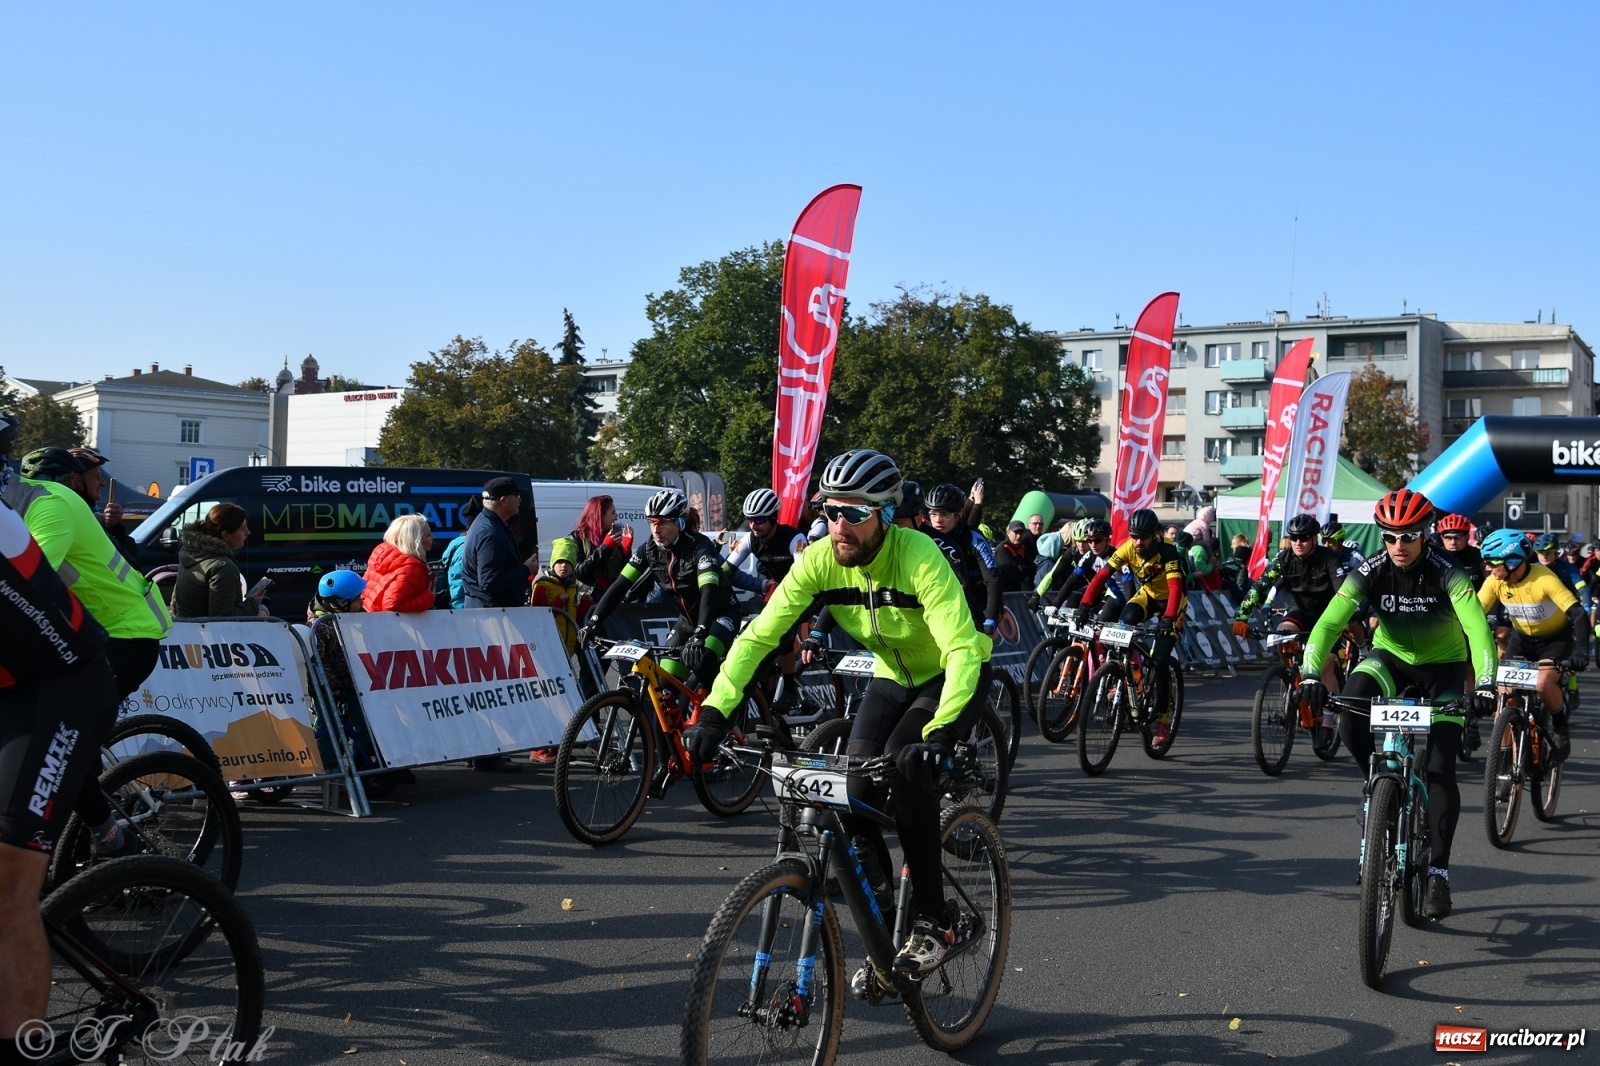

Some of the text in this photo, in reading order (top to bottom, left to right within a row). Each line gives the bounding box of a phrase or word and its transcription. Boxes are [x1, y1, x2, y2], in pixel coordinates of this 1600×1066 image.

[1297, 392, 1333, 519] RACIBÓ
[300, 475, 406, 494] bike atelier
[1105, 629, 1127, 640] 2408
[614, 645, 640, 655] 1185
[358, 643, 539, 691] YAKIMA
[844, 659, 874, 669] 2578
[1504, 670, 1532, 680] 2237
[422, 676, 566, 721] TAKE MORE FRIENDS
[1381, 710, 1420, 722] 1424
[52, 729, 80, 793] RACING TEAM
